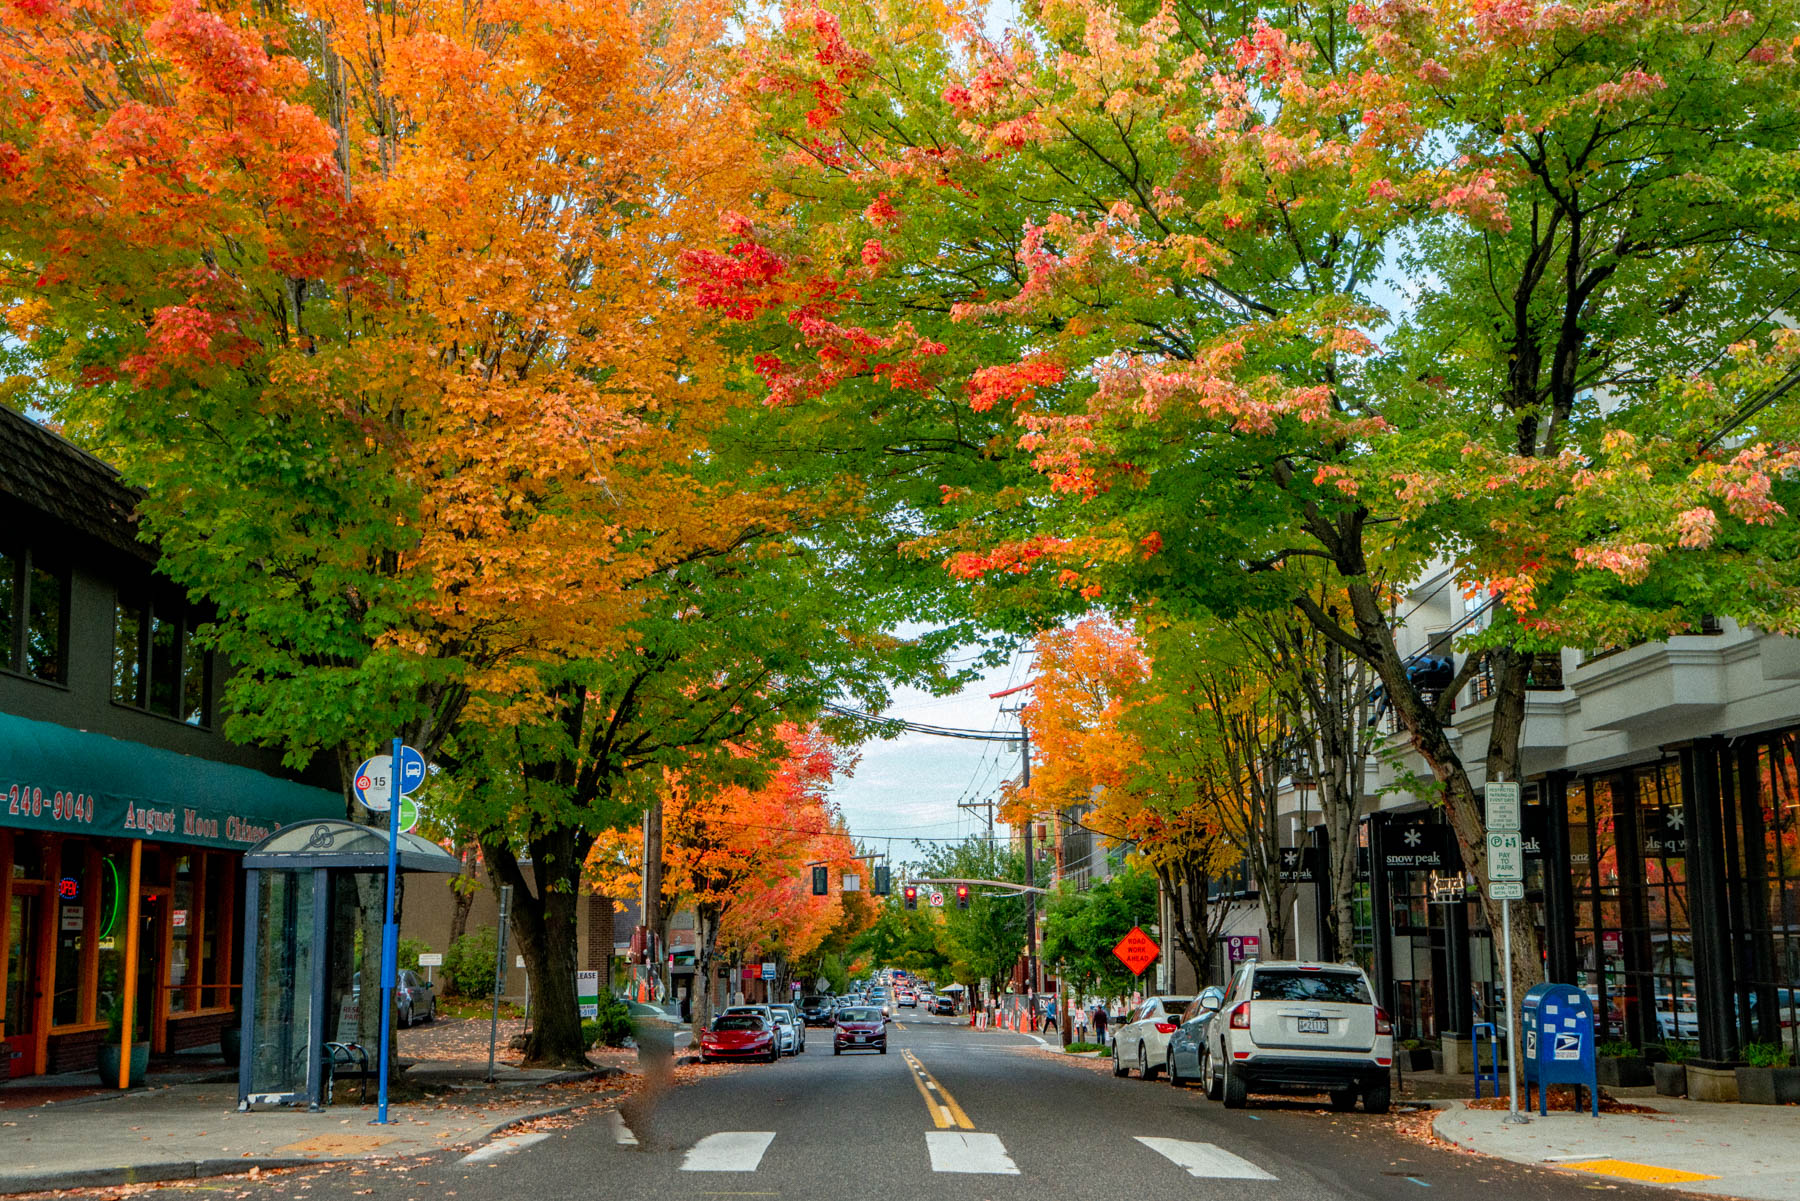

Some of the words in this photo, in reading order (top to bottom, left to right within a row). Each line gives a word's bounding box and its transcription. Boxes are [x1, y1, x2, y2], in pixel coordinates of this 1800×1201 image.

[373, 777, 386, 786] 15
[124, 801, 175, 835] August
[183, 808, 218, 838] Moon
[226, 816, 270, 843] Chinese
[1521, 837, 1540, 849] eak
[1386, 855, 1413, 863] snow
[1415, 851, 1440, 866] peak
[1293, 868, 1312, 879] pak
[61, 880, 76, 896] OPEN
[1233, 948, 1240, 957] 4
